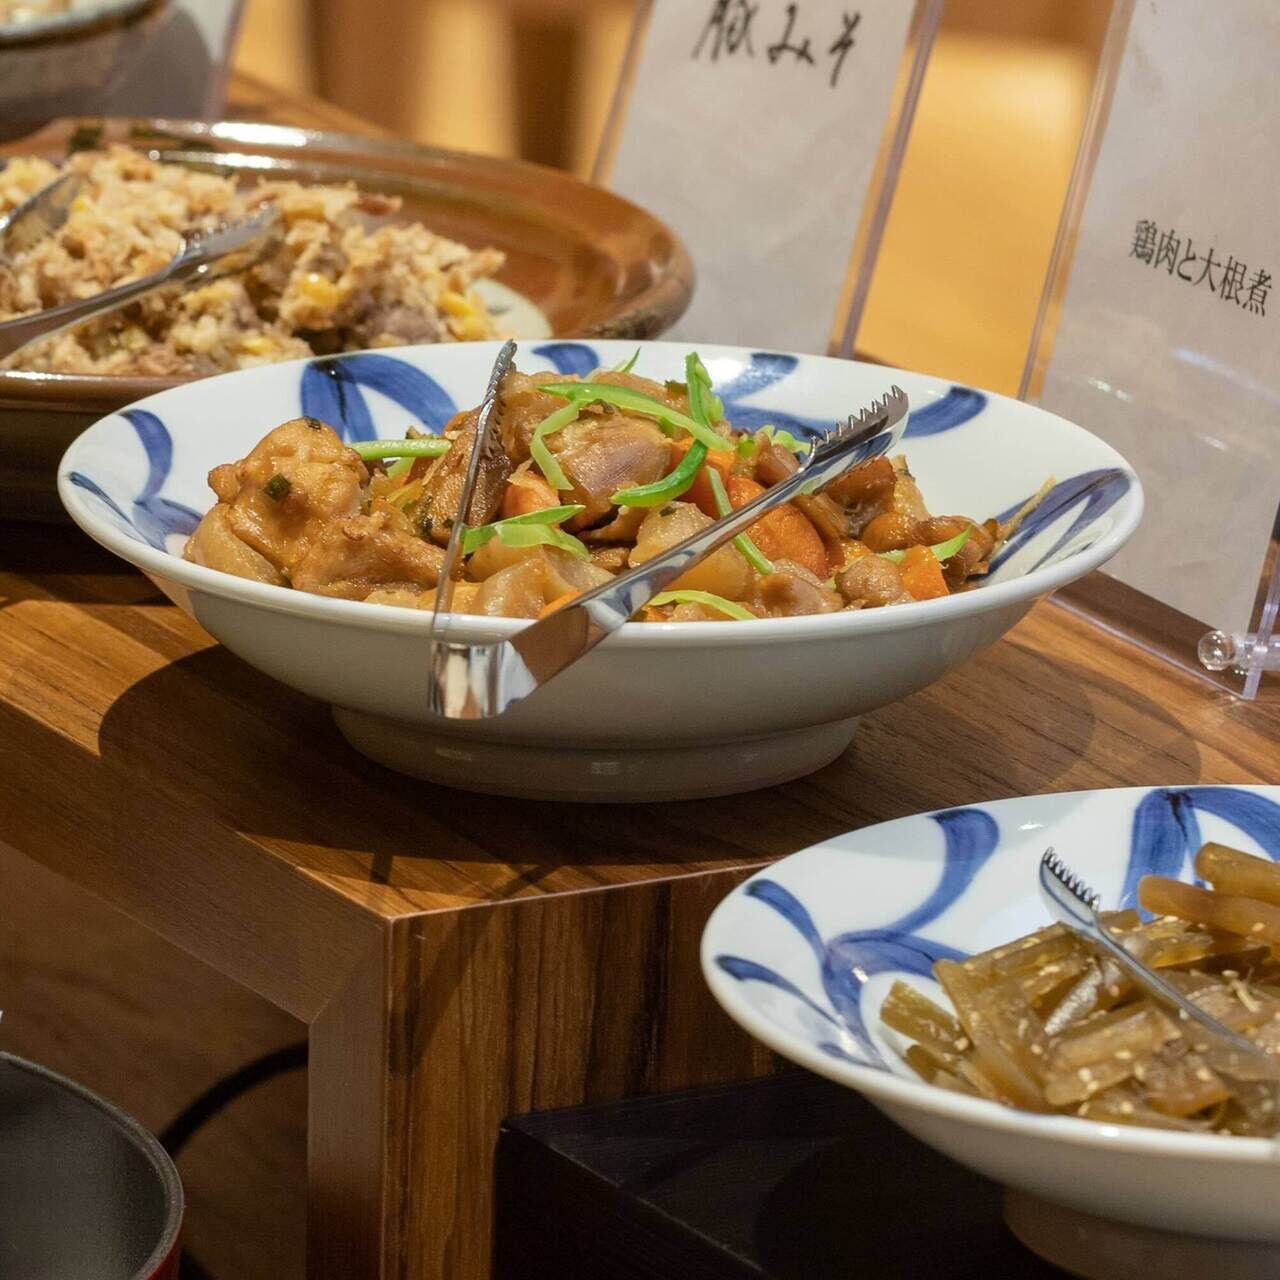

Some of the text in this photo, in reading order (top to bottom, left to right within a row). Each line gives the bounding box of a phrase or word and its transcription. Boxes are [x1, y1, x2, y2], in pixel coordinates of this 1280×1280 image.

[1129, 219, 1273, 318] 鶏肉と大根煮
